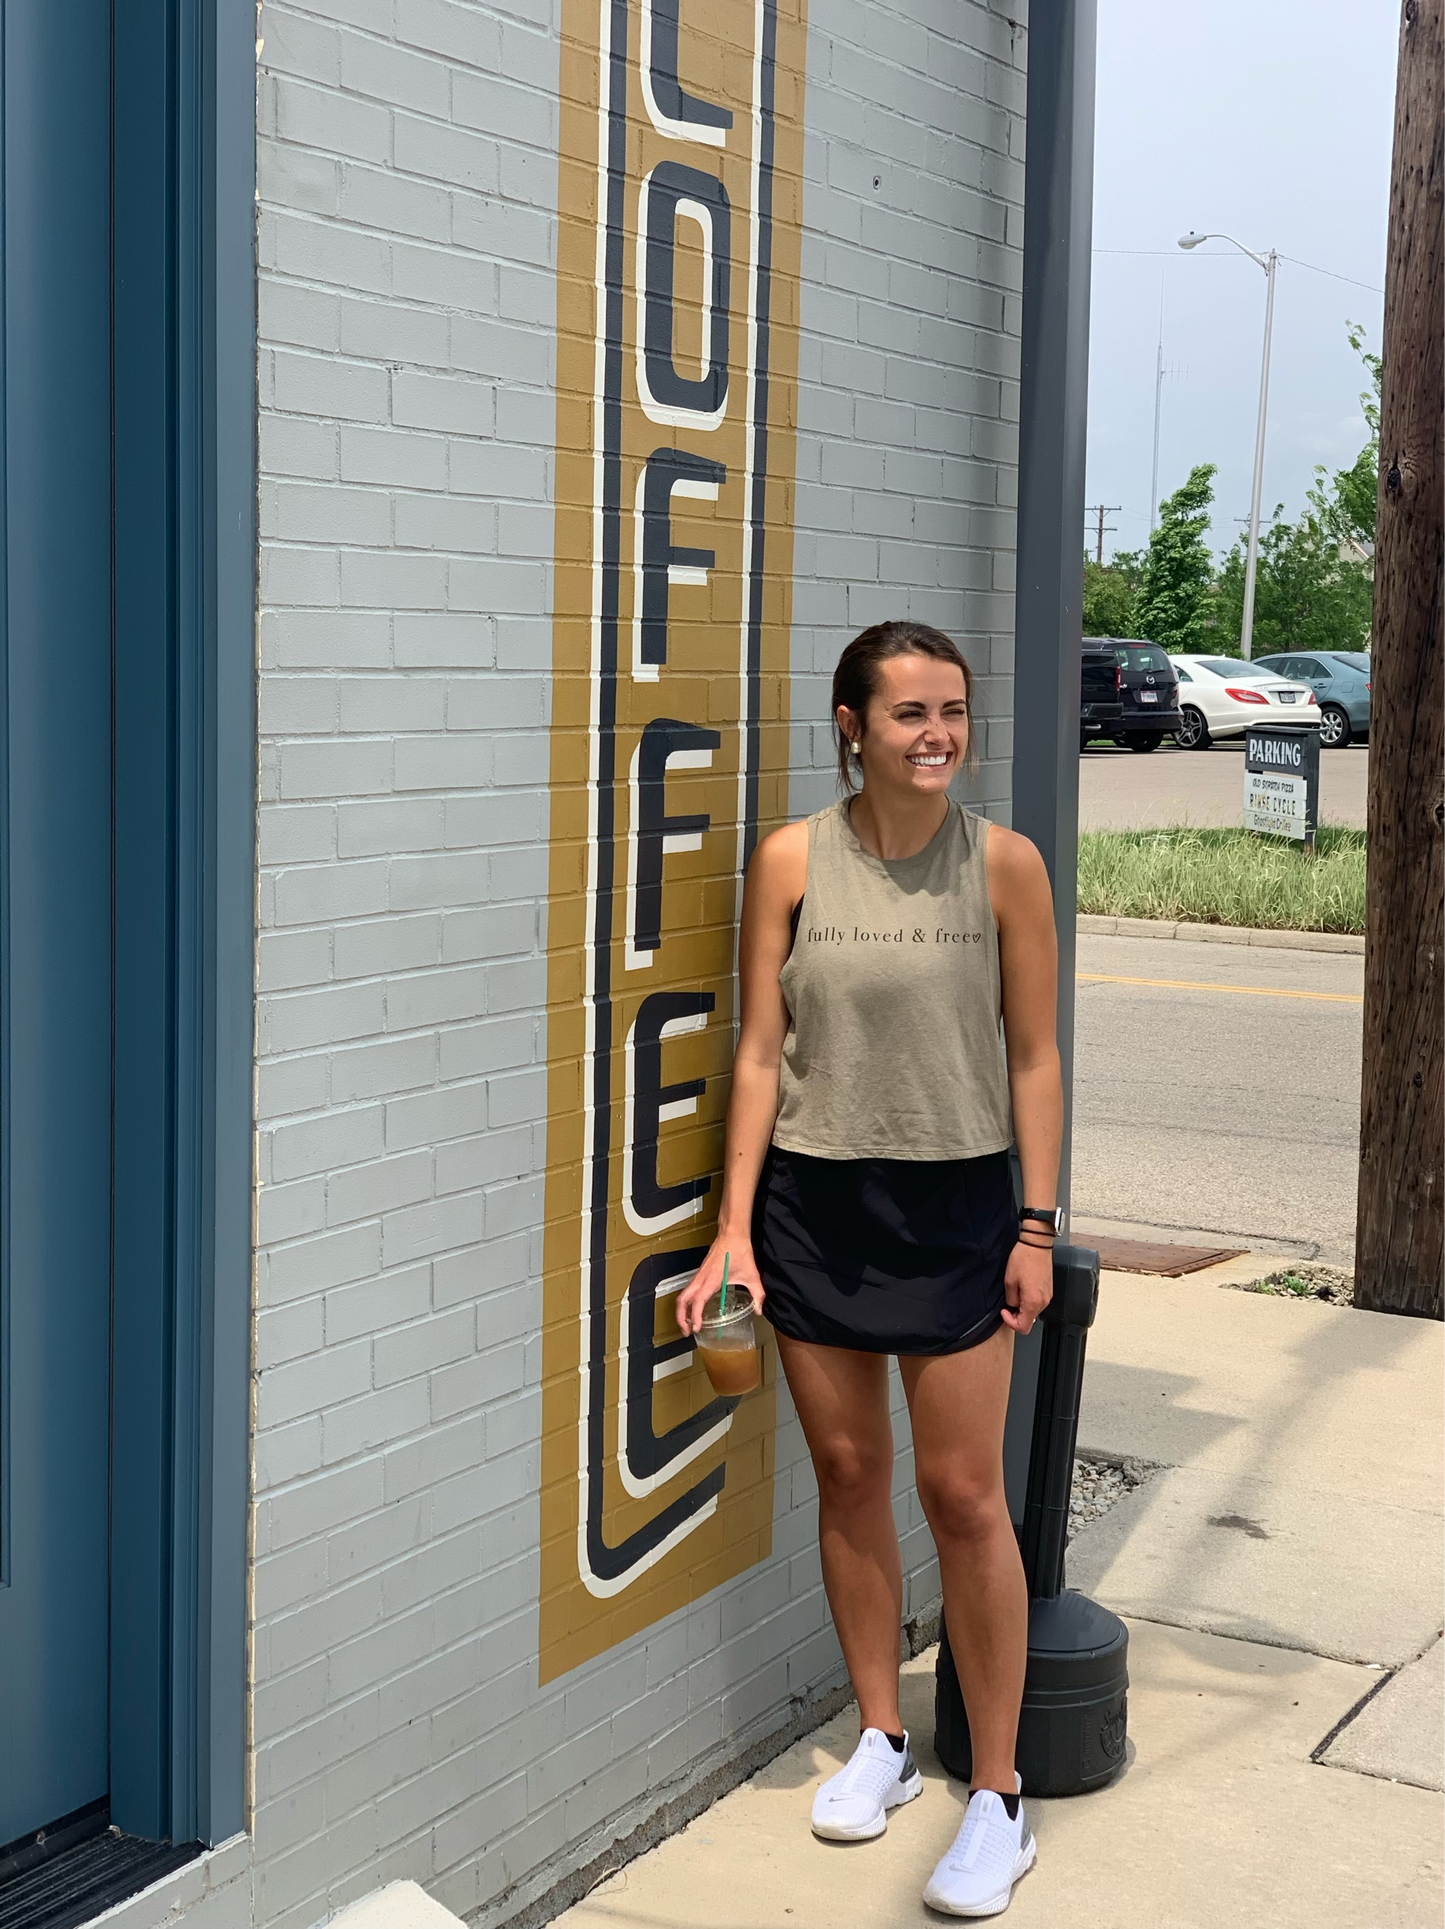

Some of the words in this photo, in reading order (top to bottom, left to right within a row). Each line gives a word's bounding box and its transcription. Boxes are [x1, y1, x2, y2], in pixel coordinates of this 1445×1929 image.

[1248, 738, 1301, 767] PARKING
[1281, 782, 1294, 793] PIZZA
[1273, 797, 1296, 815] CYCLE
[807, 927, 846, 945] fully
[853, 926, 903, 943] loved
[912, 927, 926, 943] &
[936, 927, 971, 943] free
